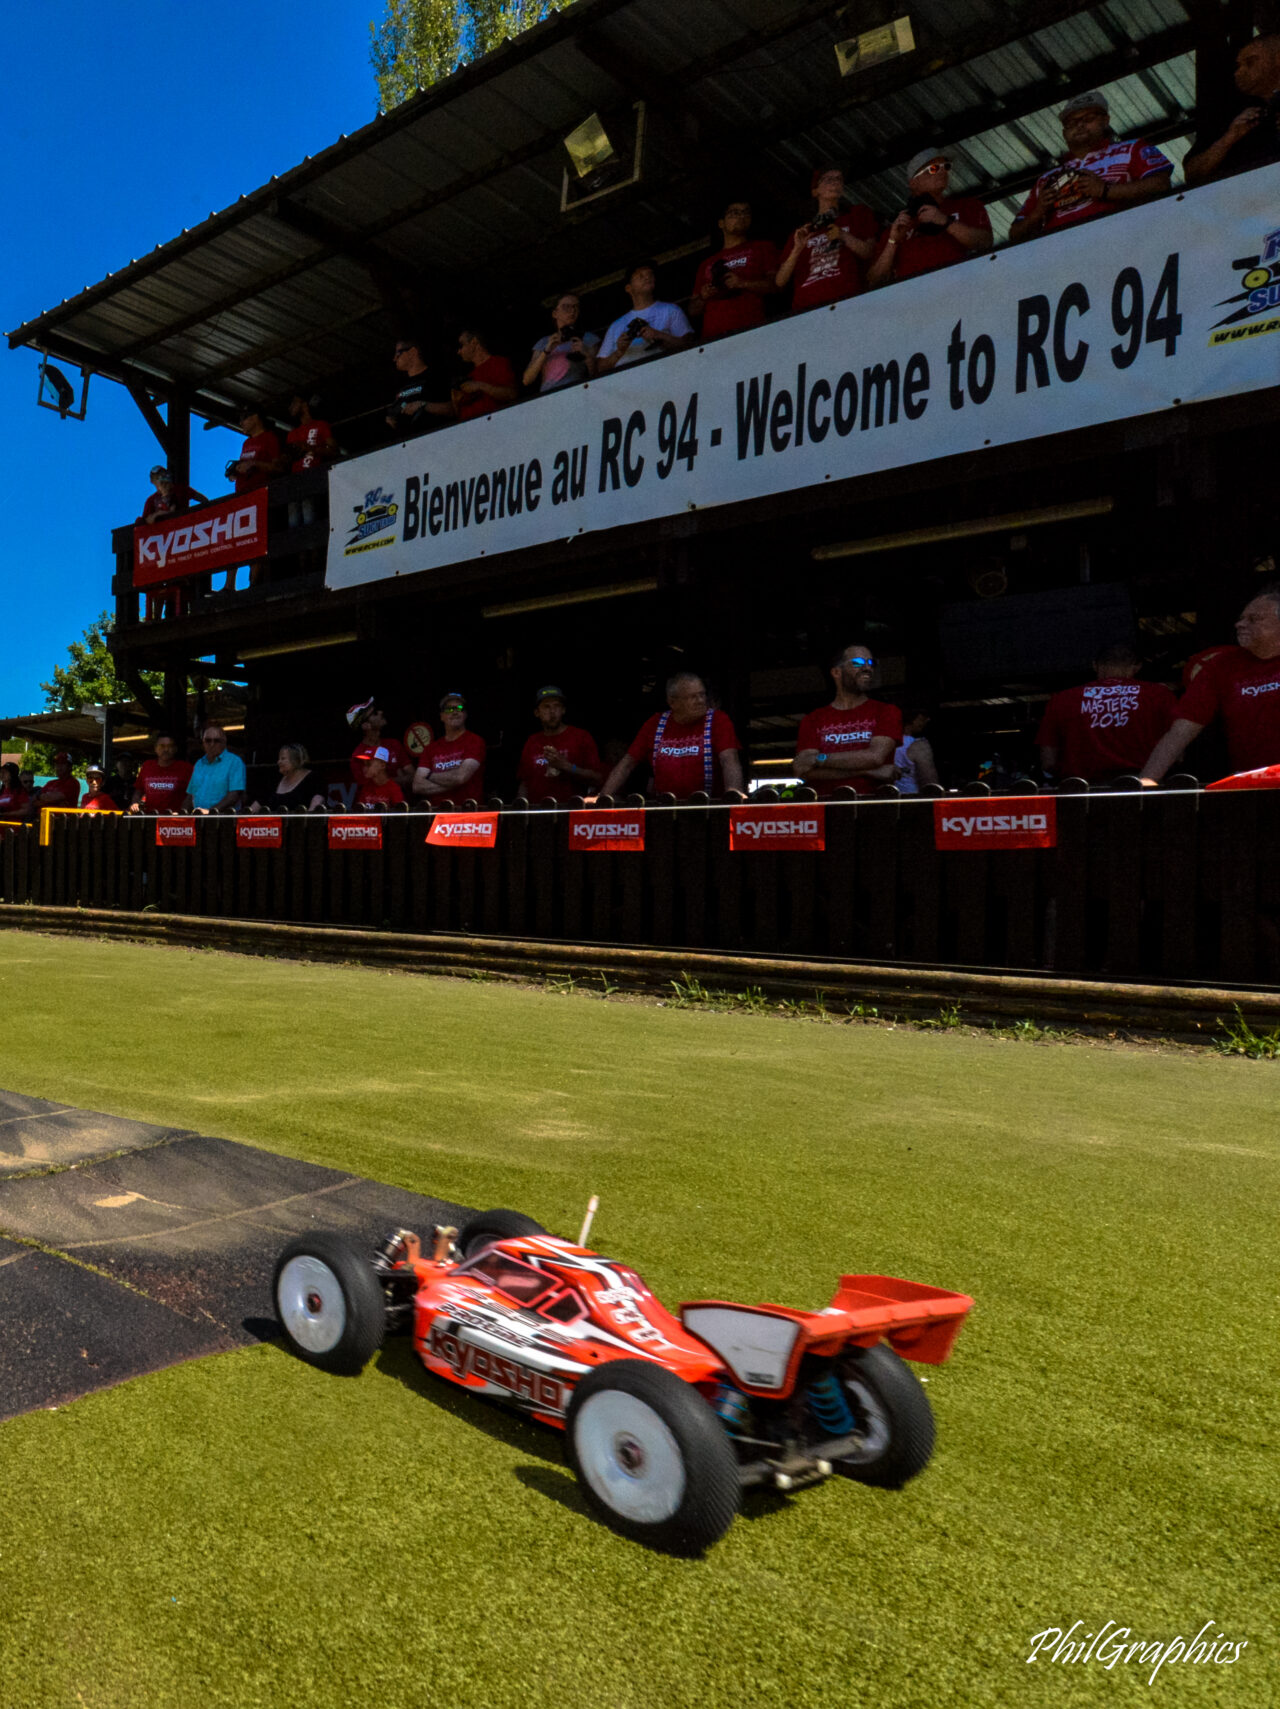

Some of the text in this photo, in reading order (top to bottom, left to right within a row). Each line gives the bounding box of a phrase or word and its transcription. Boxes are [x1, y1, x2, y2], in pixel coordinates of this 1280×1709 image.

[403, 473, 542, 541] Bienvenue
[552, 445, 588, 505] au
[599, 411, 646, 493] RC
[657, 393, 698, 479] 94
[737, 353, 929, 460] Welcome
[948, 320, 995, 410] to
[1016, 283, 1089, 393] RC
[1111, 253, 1182, 369] 94
[138, 505, 257, 568] KYOSHO
[1081, 696, 1139, 714] MASTER'S
[1090, 711, 1129, 728] 2015
[159, 826, 193, 838] KYOSHO
[239, 827, 279, 840] KYOSHO
[331, 826, 378, 840] KYOSHO
[434, 823, 492, 838] KYOSHO
[573, 823, 639, 839] KYOSHO
[736, 820, 818, 839] KYOSHO
[941, 814, 1047, 836] KYOSHO
[431, 1327, 565, 1413] KYOSHO
